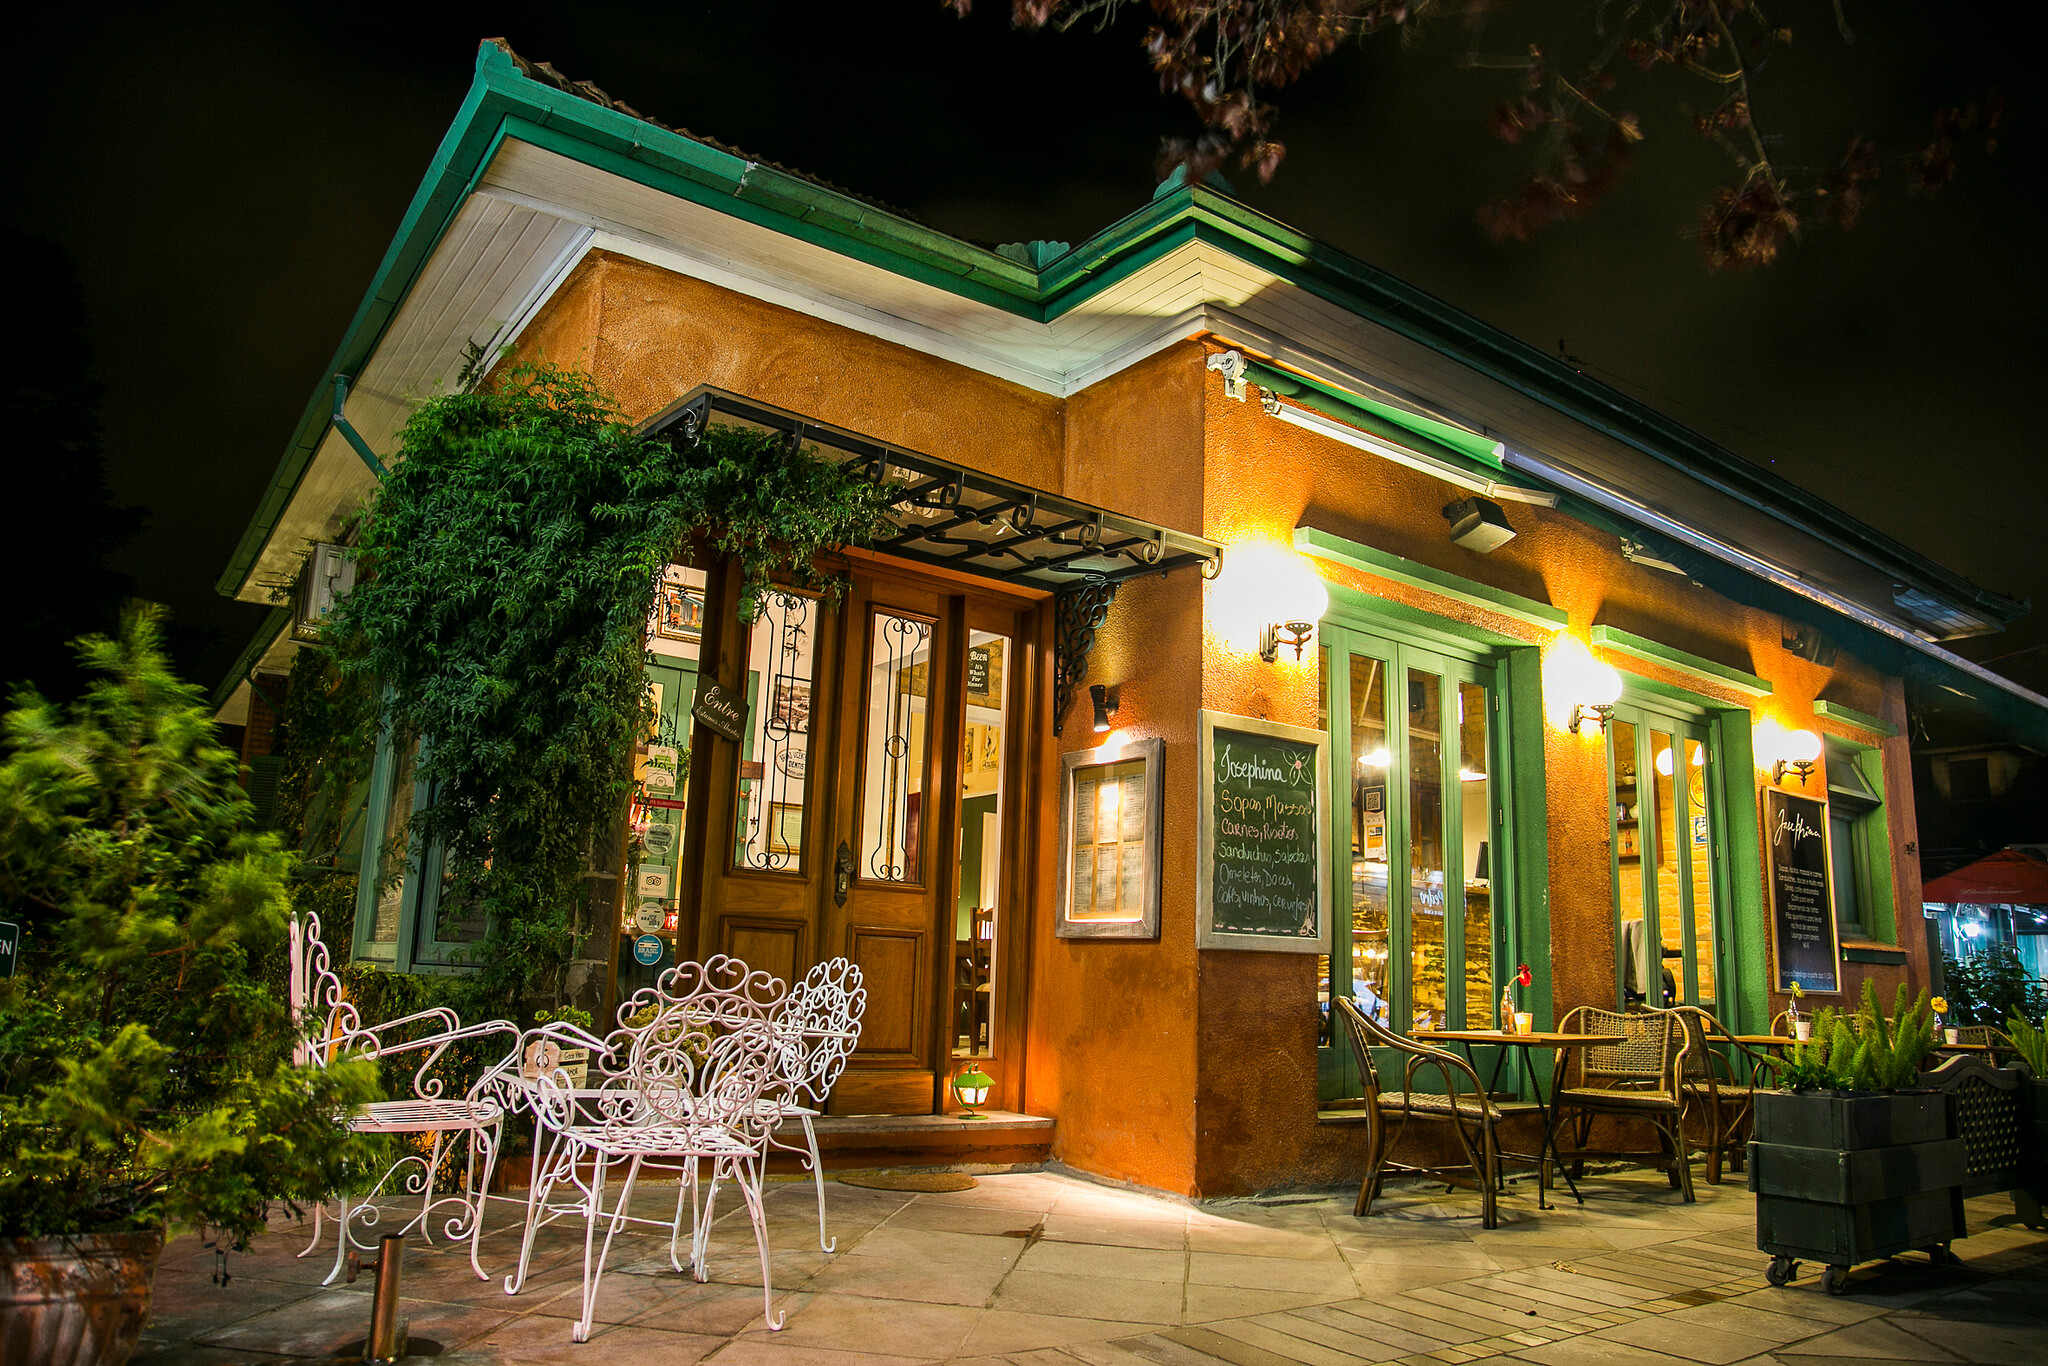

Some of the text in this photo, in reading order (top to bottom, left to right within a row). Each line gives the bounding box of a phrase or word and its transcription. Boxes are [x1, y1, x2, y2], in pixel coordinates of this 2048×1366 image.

[970, 651, 988, 661] BEER
[704, 685, 740, 722] Entre
[1218, 744, 1287, 788] Josephina
